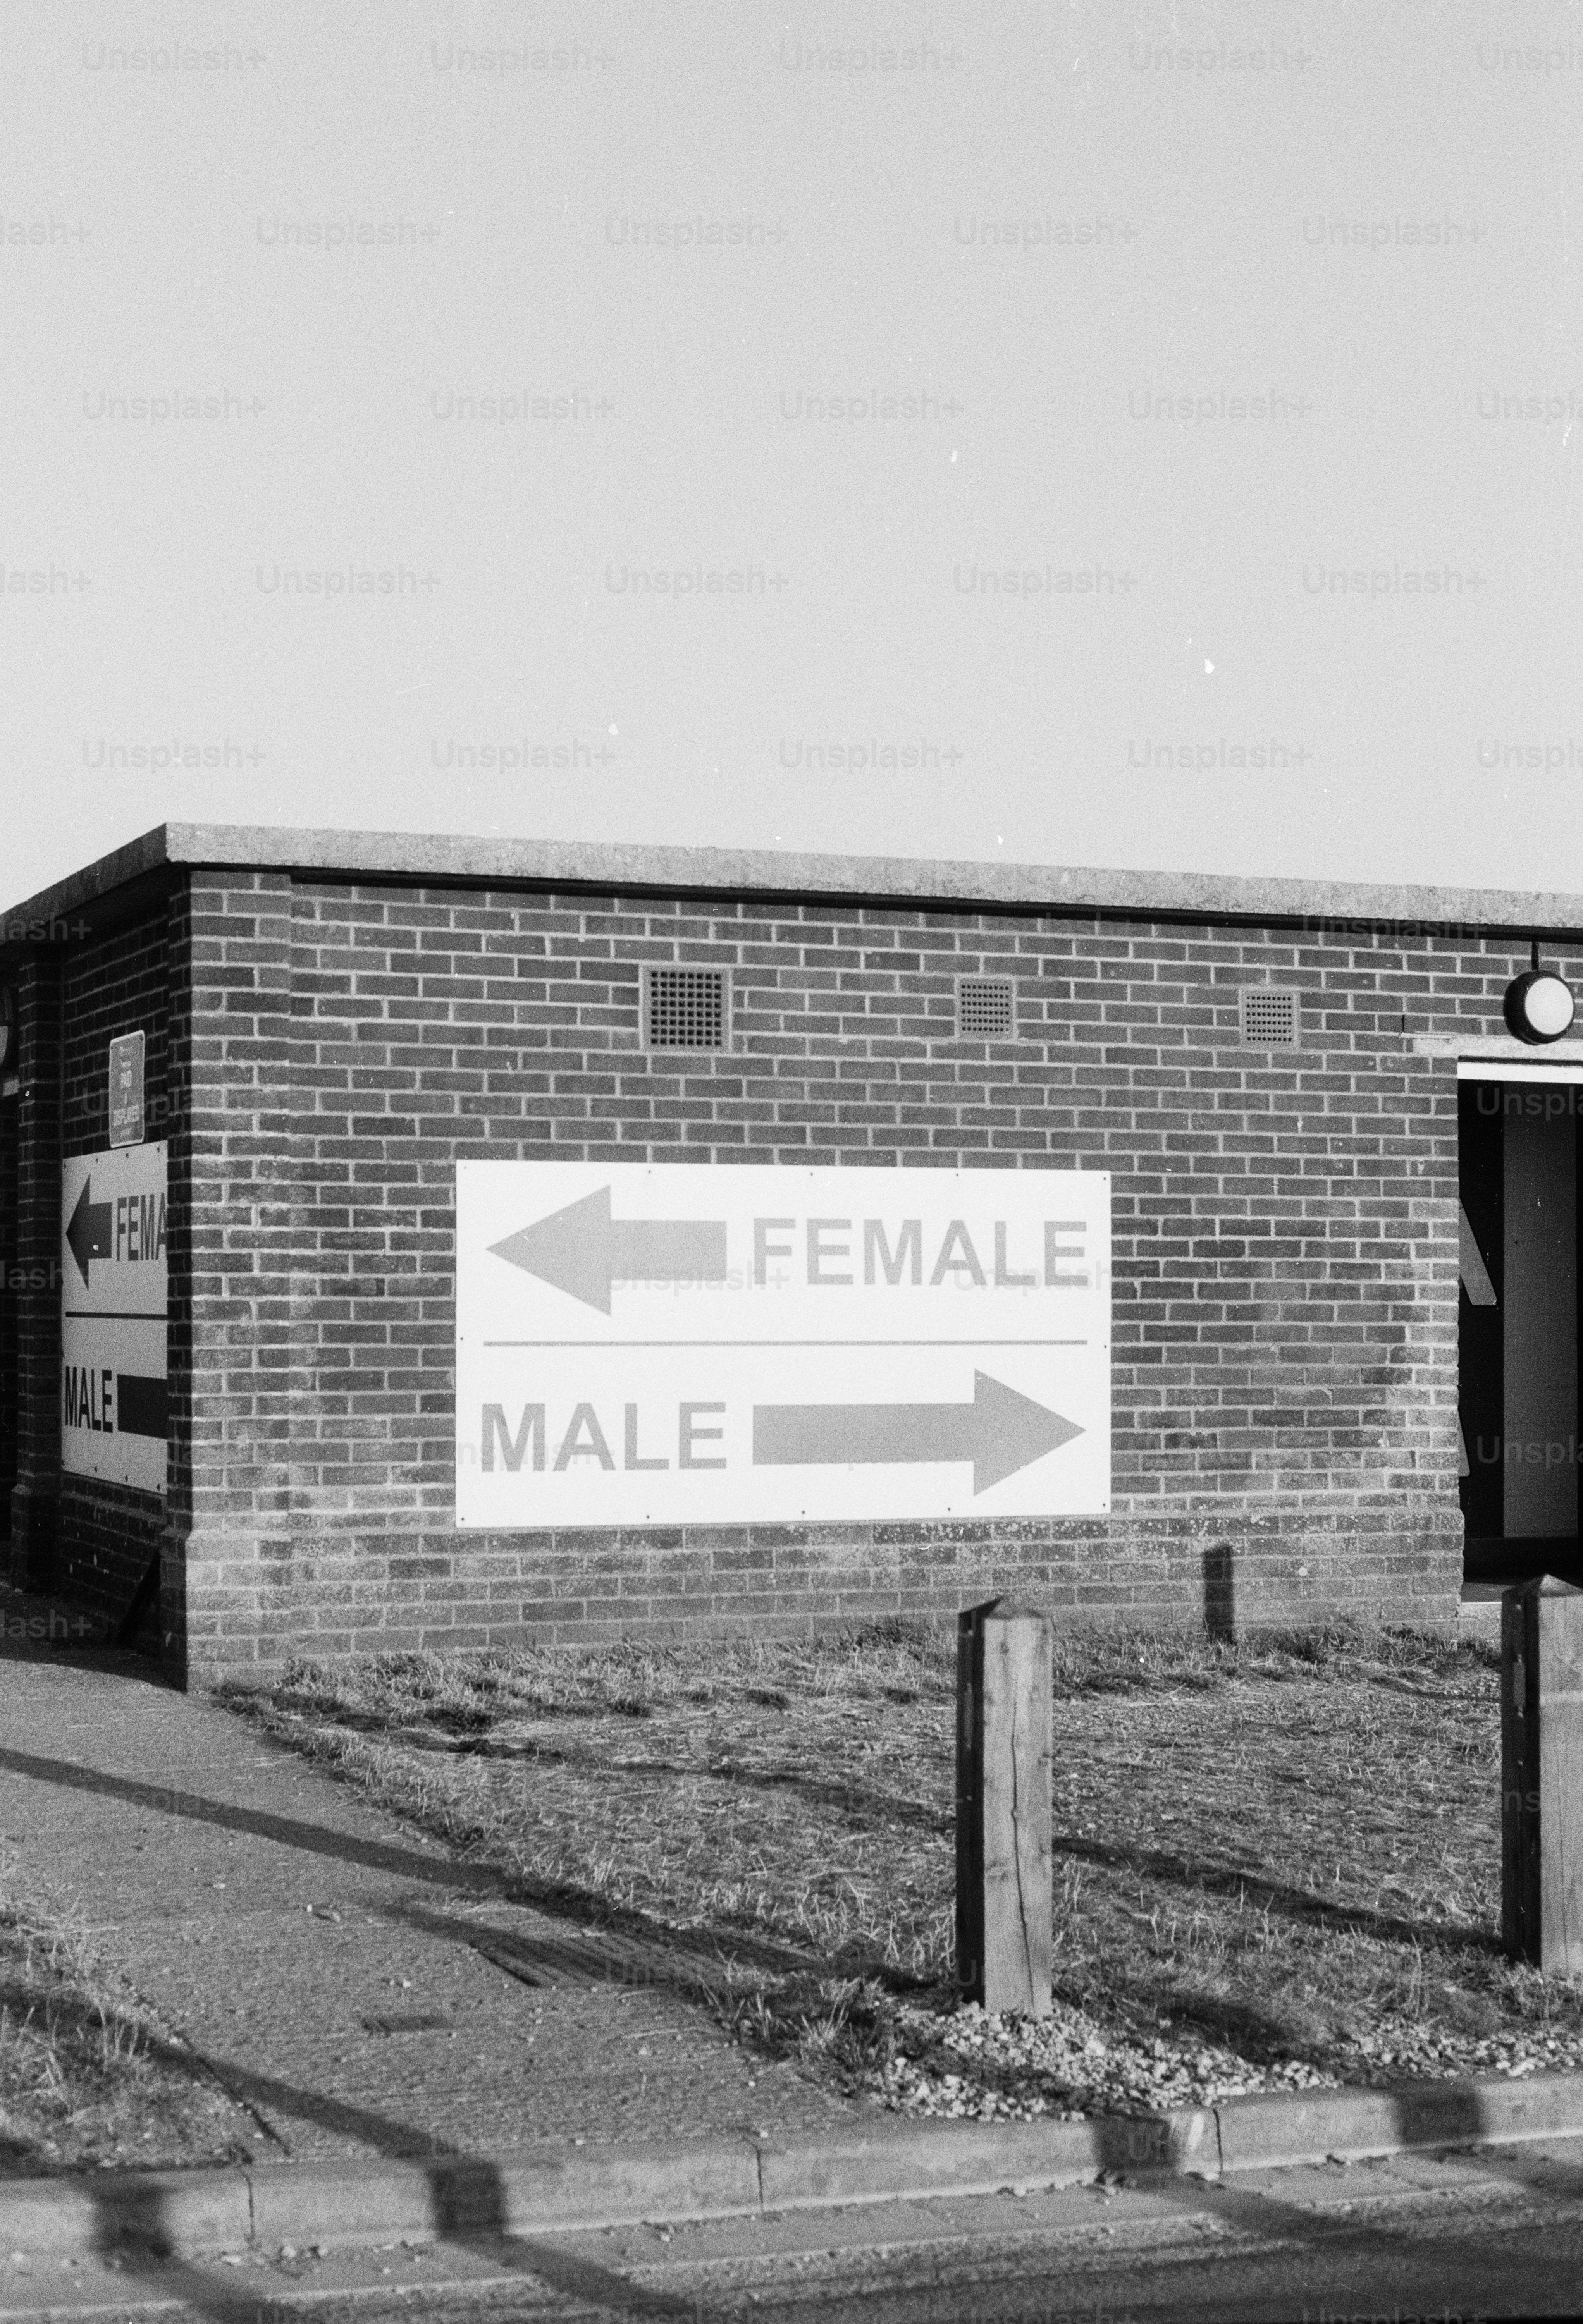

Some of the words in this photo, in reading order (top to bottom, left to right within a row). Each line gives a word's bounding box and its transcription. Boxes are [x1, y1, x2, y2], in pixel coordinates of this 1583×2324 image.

[754, 1218, 1088, 1286] FEMALE
[65, 1366, 113, 1433] MALE
[482, 1402, 726, 1472] MALE
